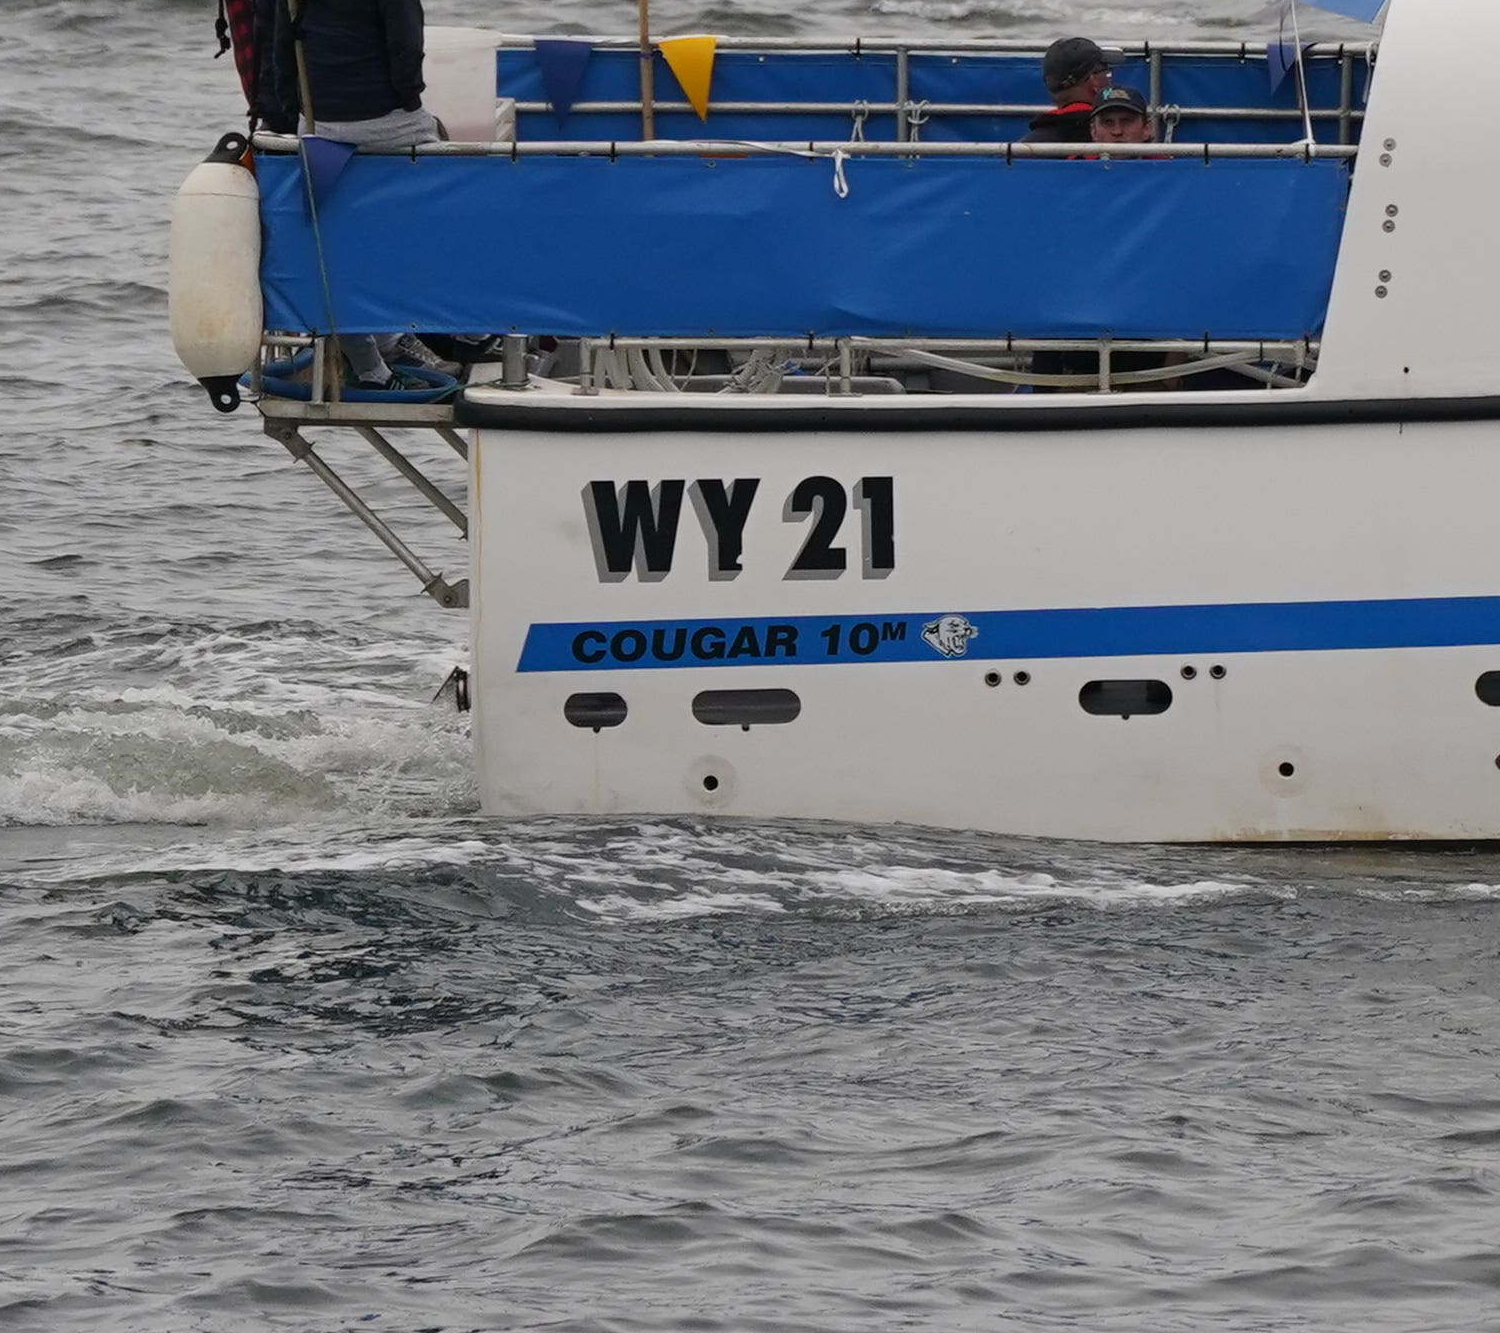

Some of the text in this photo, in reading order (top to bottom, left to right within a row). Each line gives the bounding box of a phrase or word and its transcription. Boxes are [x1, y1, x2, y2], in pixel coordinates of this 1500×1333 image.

[581, 475, 896, 583] WY 21
[571, 624, 799, 664] COUGAR
